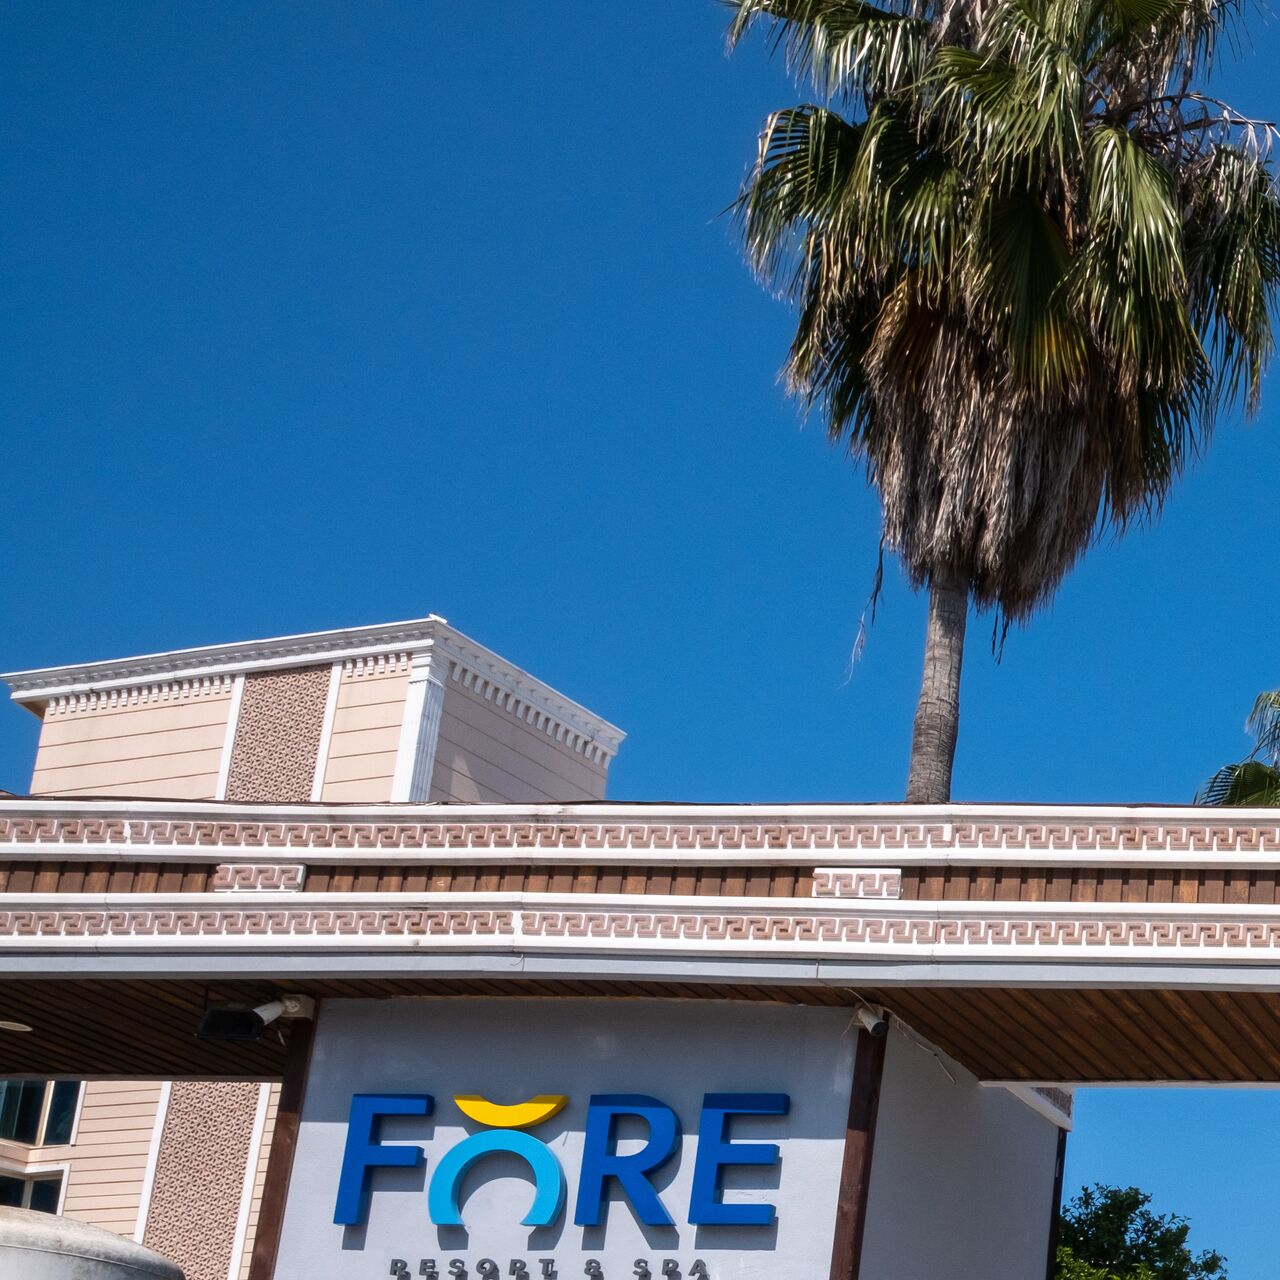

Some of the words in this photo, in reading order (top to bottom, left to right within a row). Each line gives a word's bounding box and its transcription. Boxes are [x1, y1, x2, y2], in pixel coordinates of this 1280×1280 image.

[390, 1258, 554, 1277] RESORT
[584, 1258, 601, 1277] &
[633, 1258, 708, 1277] SPA
